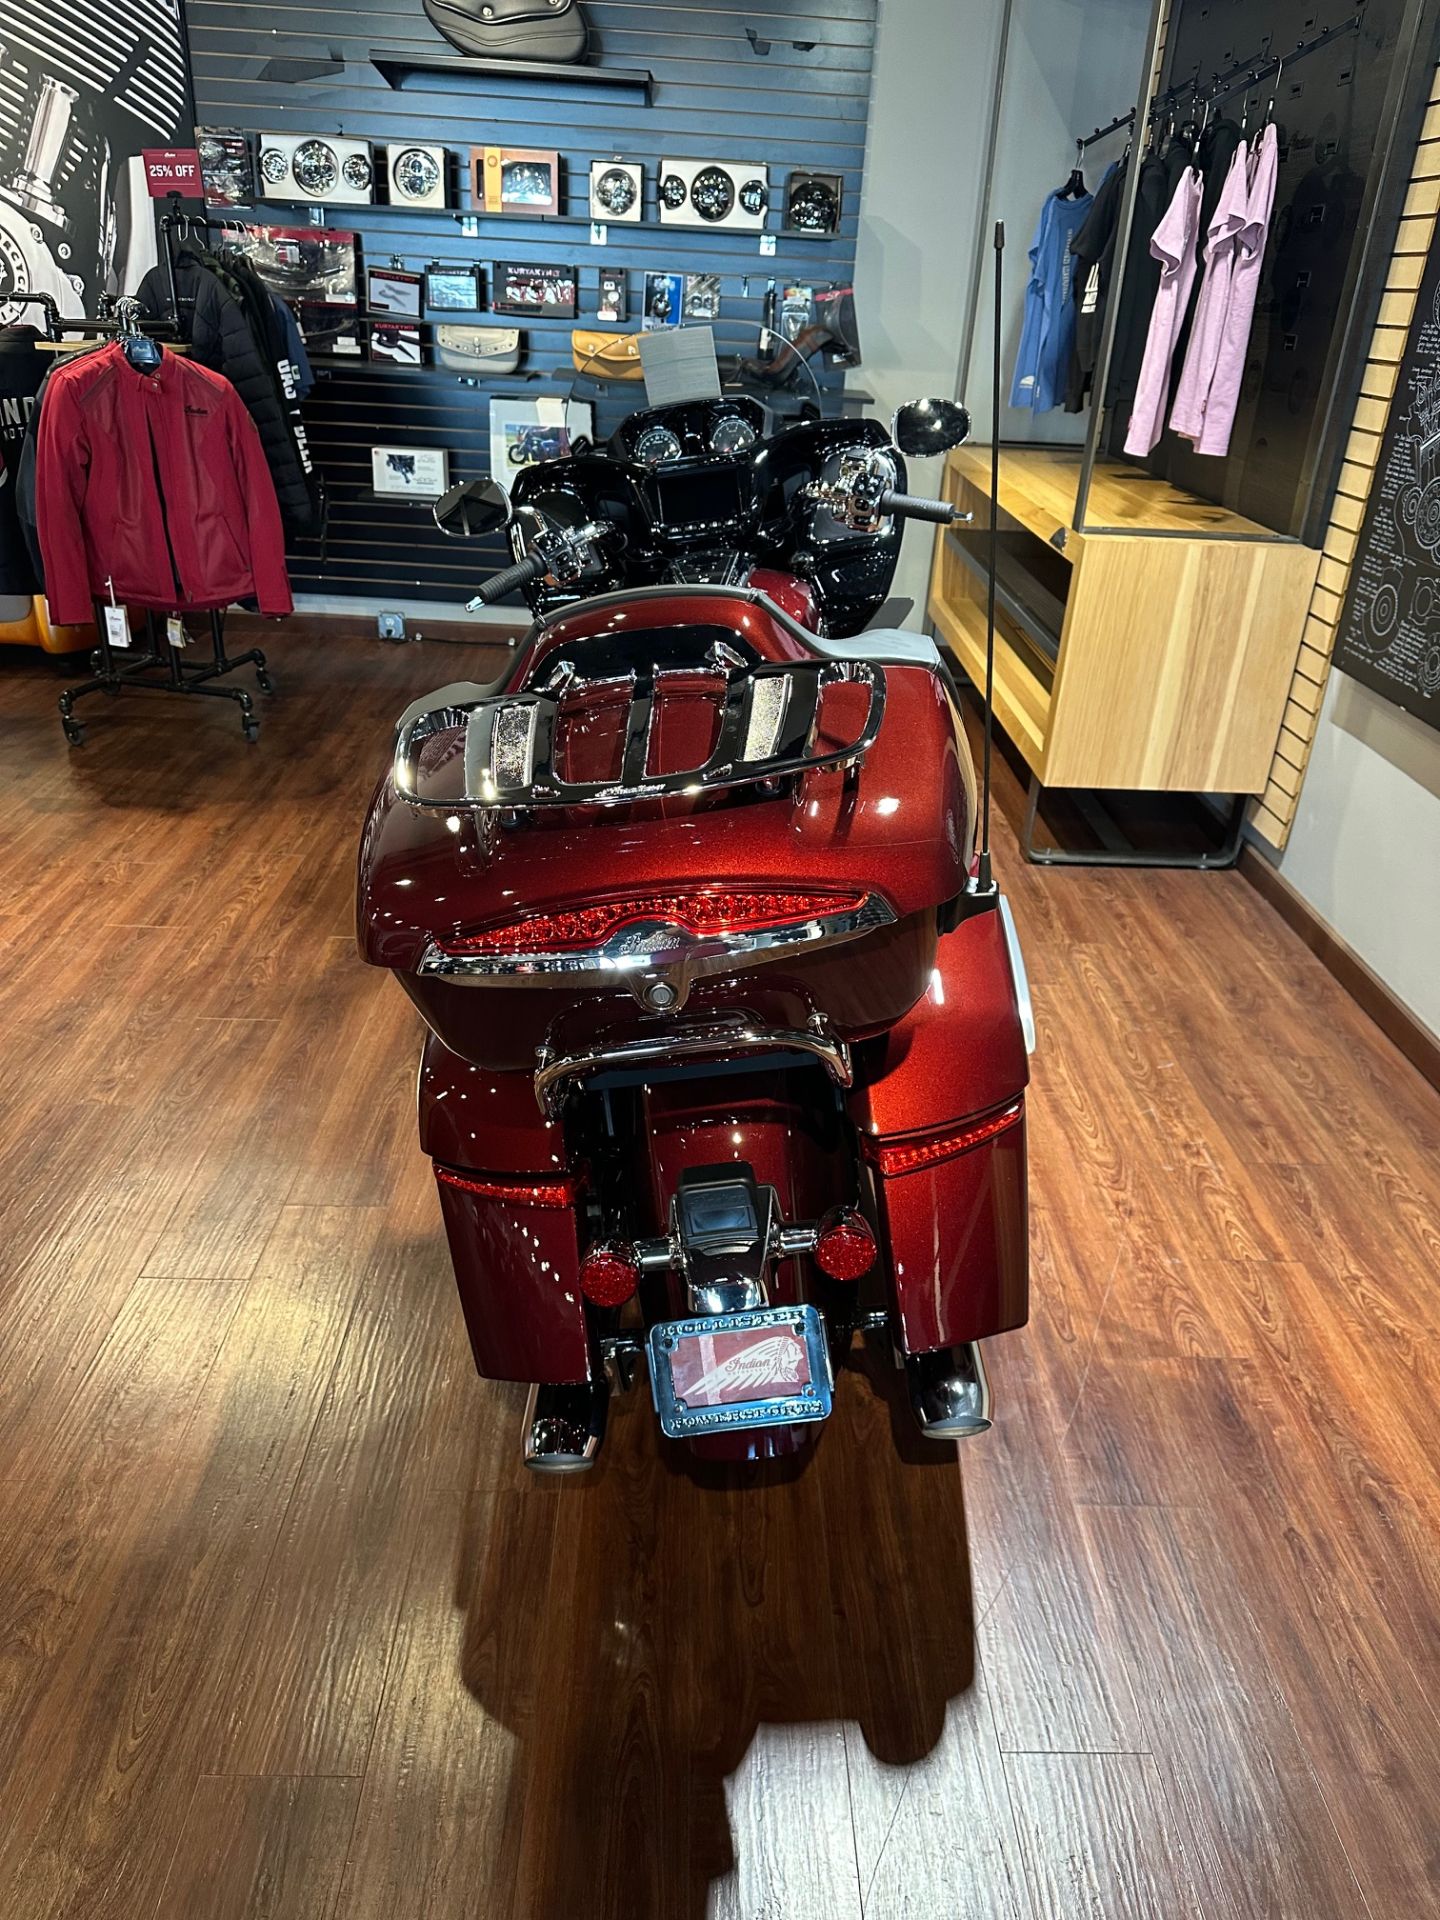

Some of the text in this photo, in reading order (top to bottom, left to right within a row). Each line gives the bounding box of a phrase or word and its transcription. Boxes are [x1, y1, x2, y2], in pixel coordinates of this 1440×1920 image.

[149, 164, 195, 177] 25% OFF
[724, 1357, 771, 1373] Indian
